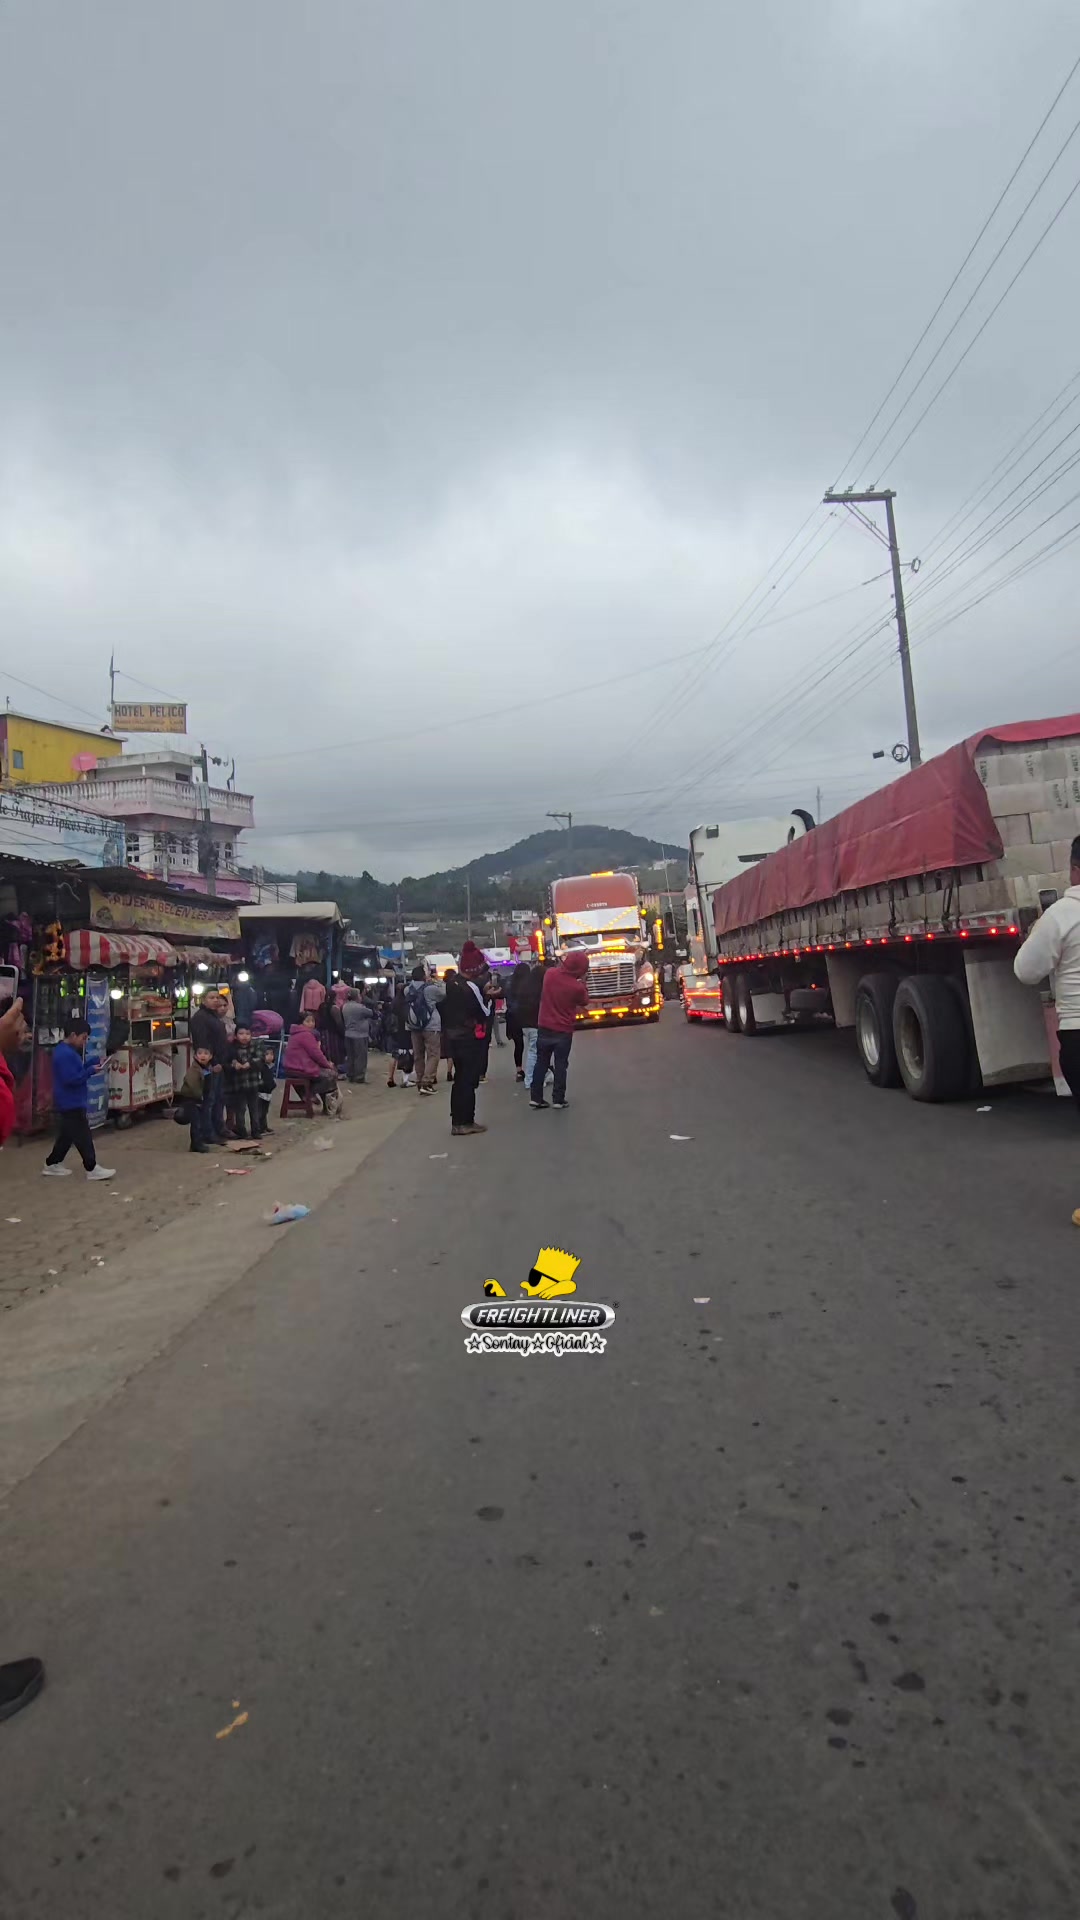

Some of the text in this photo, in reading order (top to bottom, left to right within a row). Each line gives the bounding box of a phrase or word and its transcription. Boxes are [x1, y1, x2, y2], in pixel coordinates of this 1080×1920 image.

[114, 704, 184, 717] HOTEL PELICO
[158, 900, 191, 918] BELEN
